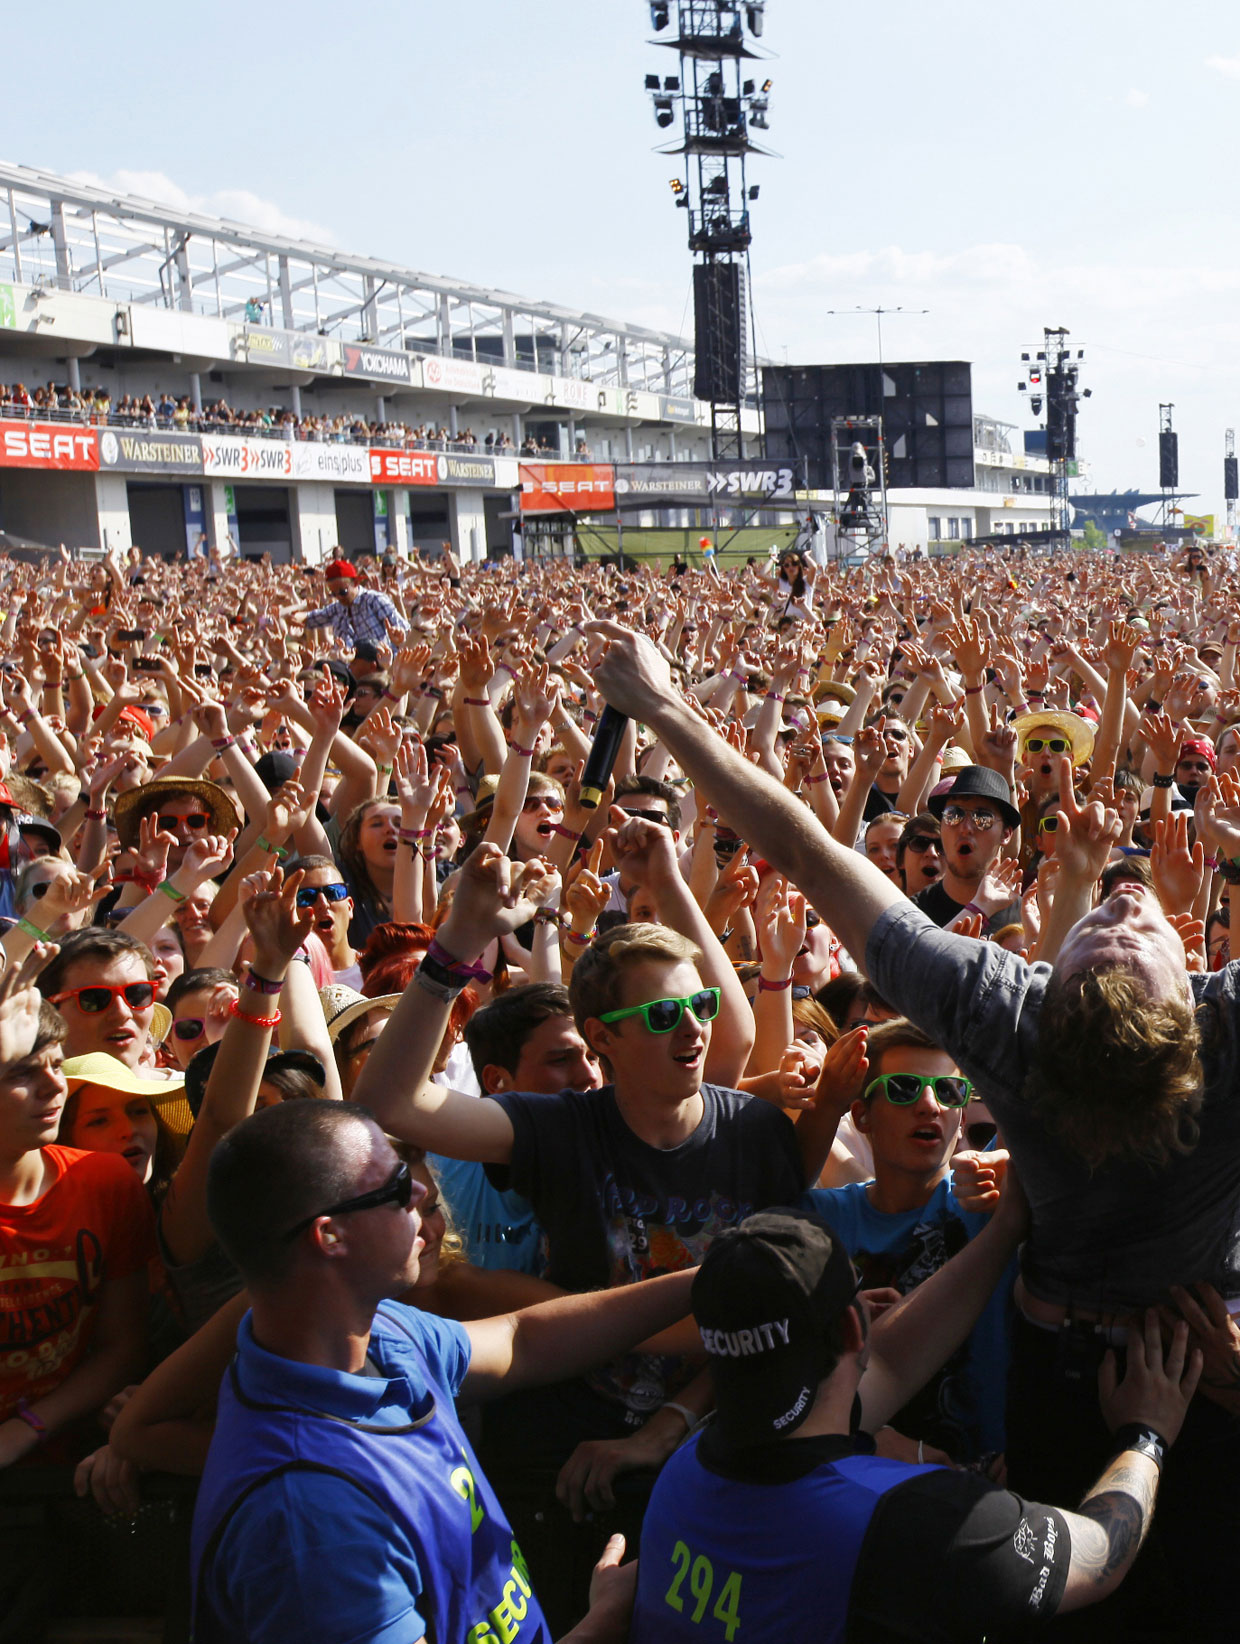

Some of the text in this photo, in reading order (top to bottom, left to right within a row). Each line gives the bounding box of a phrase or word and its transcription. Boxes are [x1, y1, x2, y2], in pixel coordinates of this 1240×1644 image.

[361, 351, 408, 377] YOKOHAMA
[4, 430, 95, 461] SEAT
[120, 436, 201, 465] WARSTEINER
[385, 456, 435, 478] SEAT
[541, 480, 611, 493] SEAT
[630, 480, 702, 491] WARSTEINER
[727, 469, 793, 495] SWR3
[699, 1318, 790, 1358] SECURITY
[773, 1386, 811, 1430] SECURITY
[665, 1540, 743, 1643] 294
